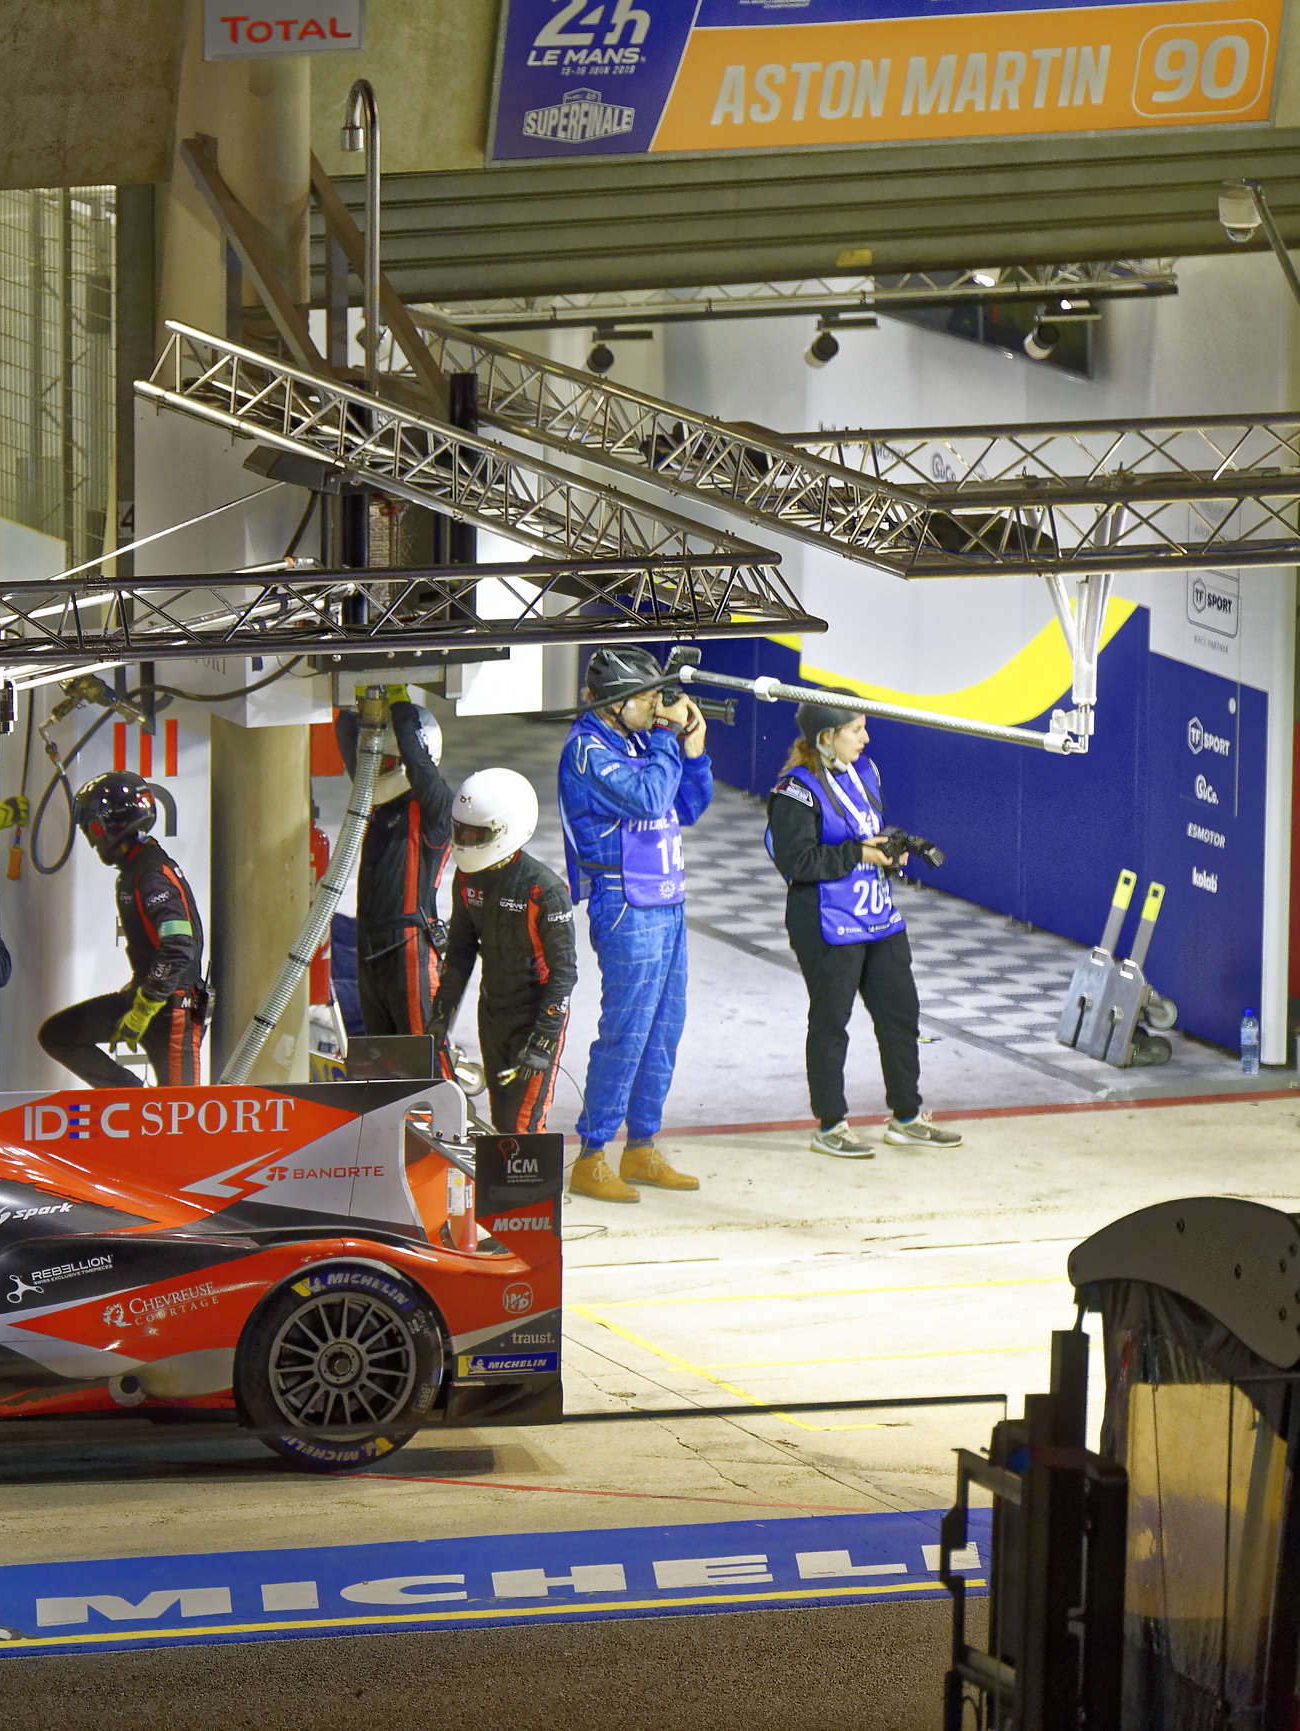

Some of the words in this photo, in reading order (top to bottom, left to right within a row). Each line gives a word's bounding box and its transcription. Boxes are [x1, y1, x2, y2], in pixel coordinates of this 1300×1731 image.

[220, 16, 351, 44] TOTAL
[526, 50, 562, 66] LE
[563, 48, 641, 65] MANS
[1152, 35, 1250, 103] 90
[711, 58, 890, 126] ASTON
[901, 45, 1110, 116] MARTIN
[526, 103, 634, 141] SUPERFINALE
[1207, 593, 1233, 614] SPORT
[1204, 732, 1231, 757] SPORT
[1192, 866, 1218, 894] kolab
[24, 1102, 130, 1141] IDEC
[141, 1098, 295, 1137] SPORT
[292, 1165, 385, 1180] BANORTE
[507, 1158, 539, 1174] ICM
[12, 1202, 74, 1222] spark
[492, 1216, 553, 1232] MOTUL
[32, 1254, 112, 1281] REBELLION
[129, 1281, 214, 1315] CHEVREUSE
[327, 1272, 409, 1305] MICHELIN
[512, 1332, 556, 1346] traust.
[488, 1357, 547, 1370] MICHELIN
[37, 1541, 983, 1627] MICHELI
